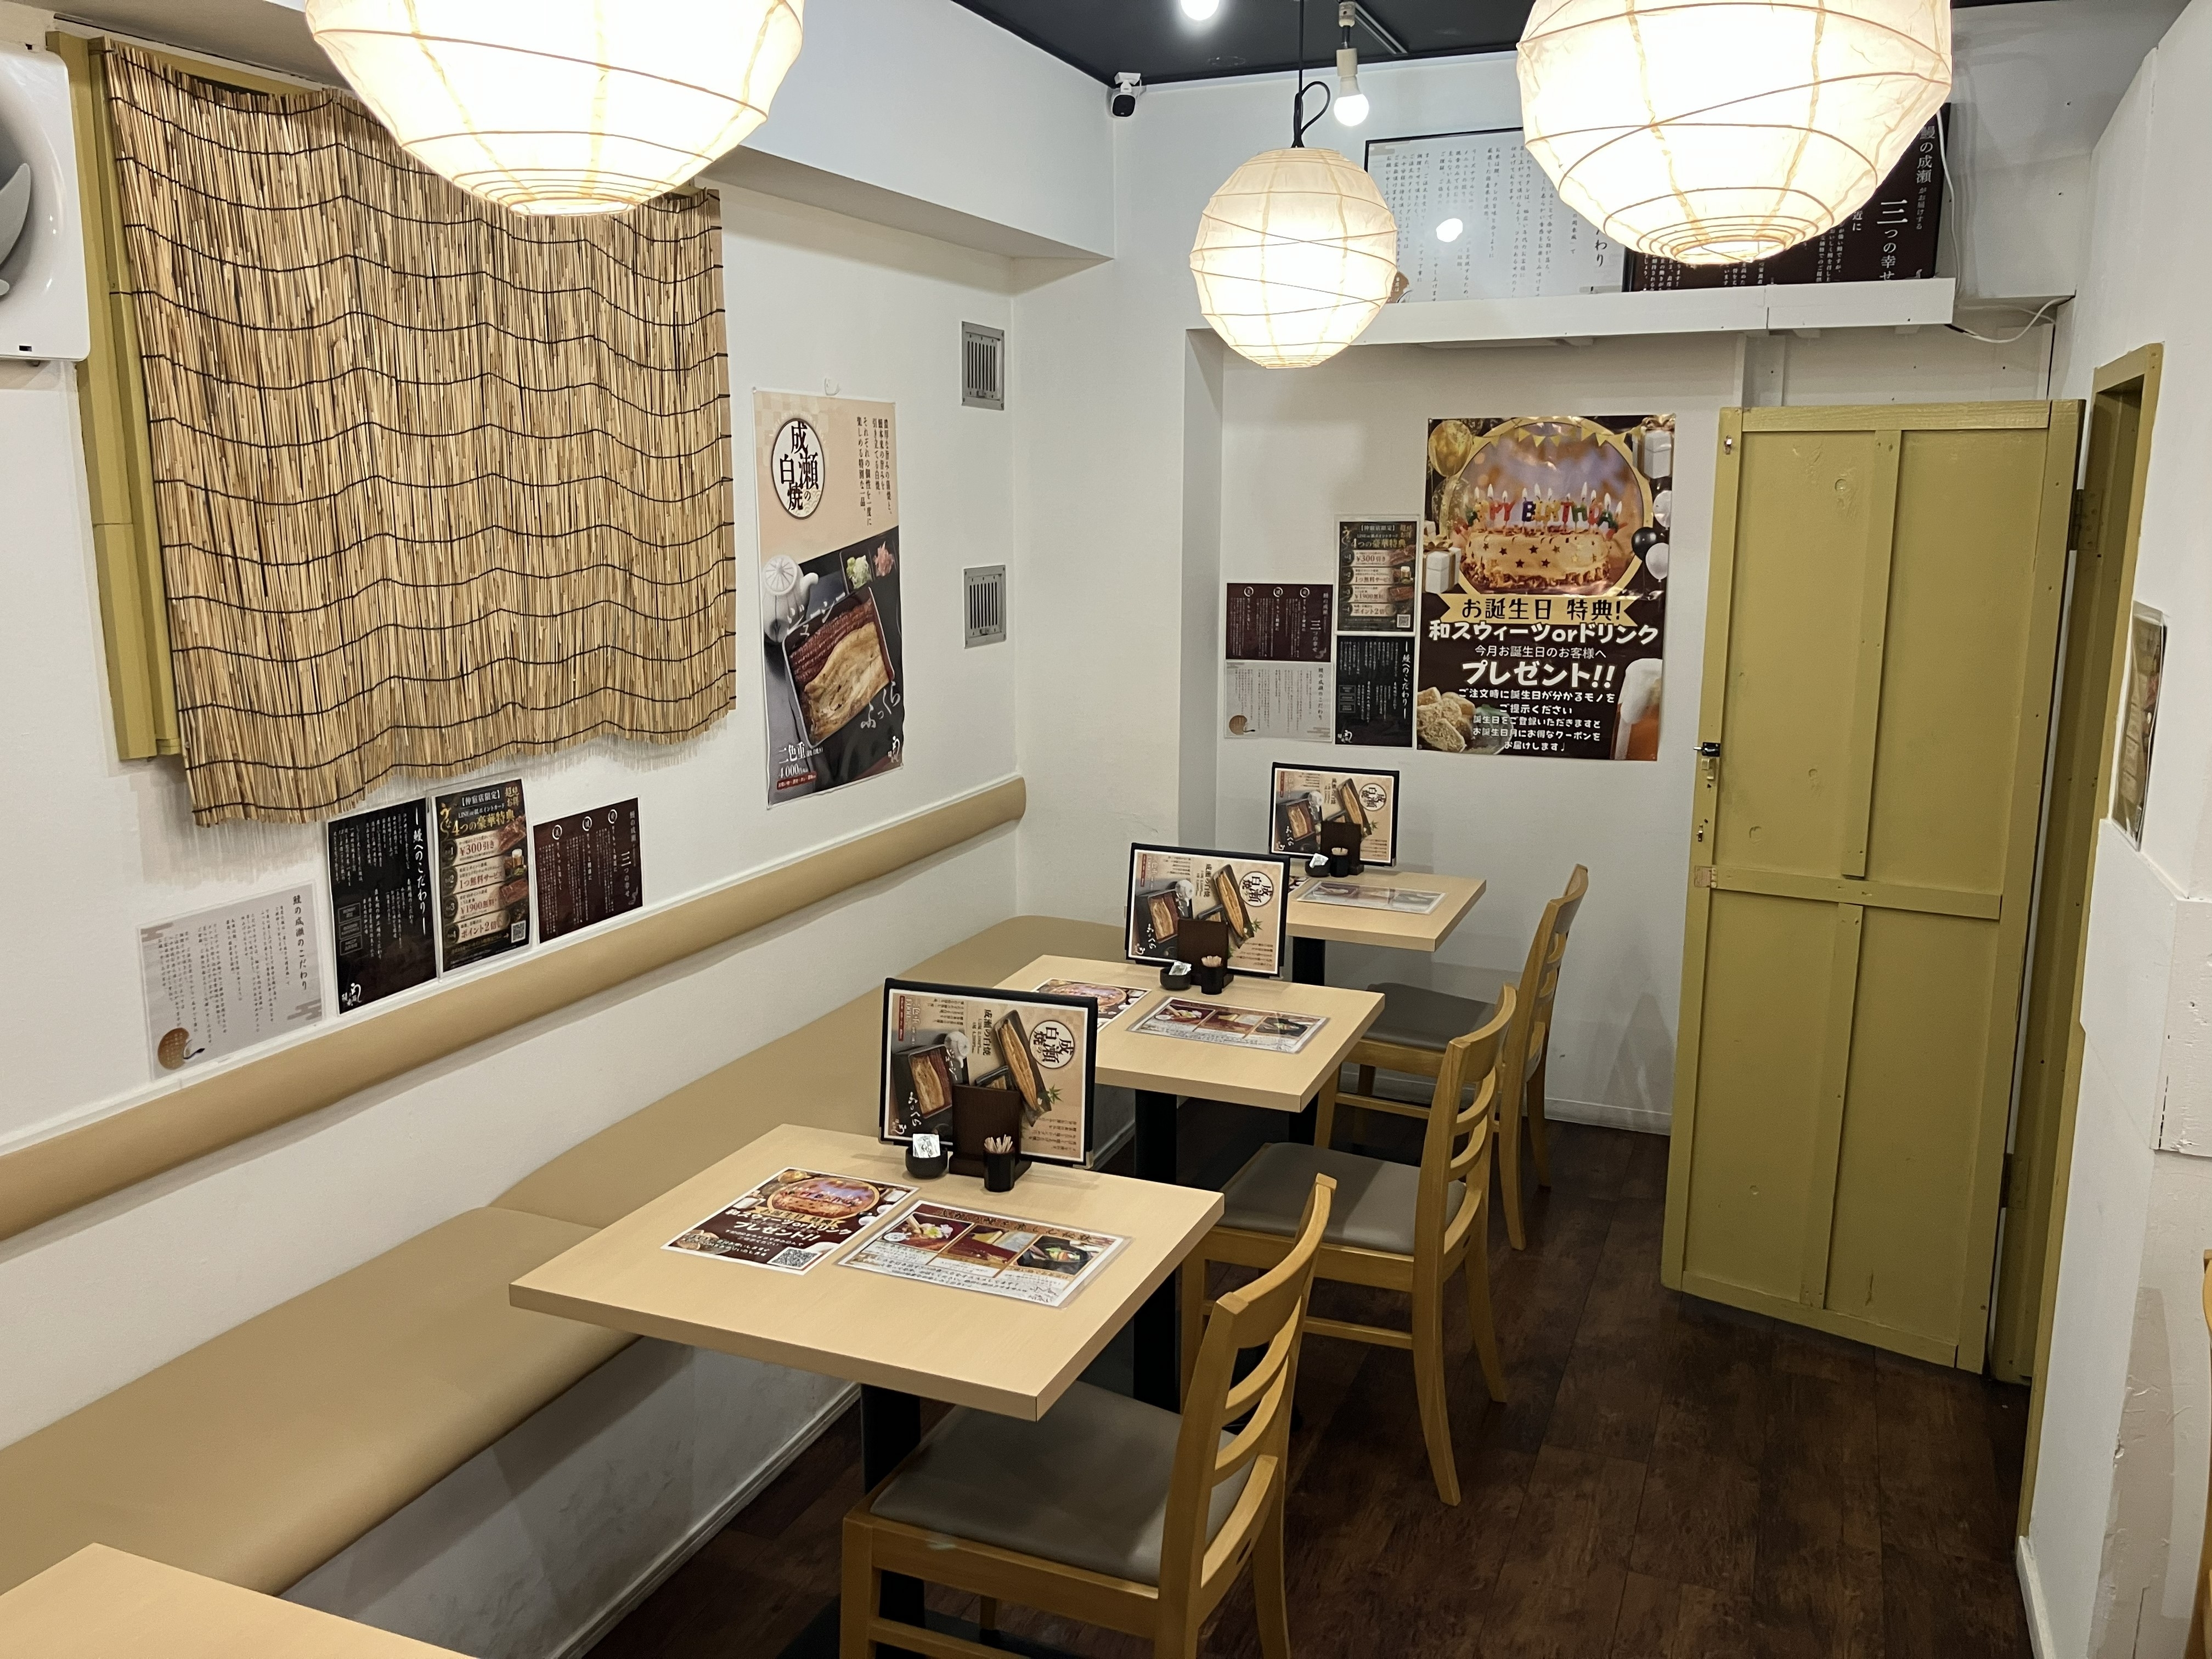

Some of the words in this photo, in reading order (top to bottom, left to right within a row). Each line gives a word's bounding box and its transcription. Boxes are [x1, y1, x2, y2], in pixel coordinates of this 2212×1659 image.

[863, 417, 872, 526] それぞれの個性を一度に
[1462, 597, 1551, 620] お誕生日
[1566, 597, 1621, 621] 特典!
[1429, 620, 1658, 645] 和スウィーツorドリンク
[1475, 645, 1606, 659] 今月お誕生日のお客様へ
[1462, 660, 1615, 689] プレゼント!!
[1458, 689, 1615, 703] ご注文時に誕生日が分かるモノを
[1499, 703, 1572, 715] ご提示ください
[1473, 715, 1601, 729] 誕生日をご登録いただきますと
[1472, 727, 1601, 741] お誕生日月にお得なクーポンを
